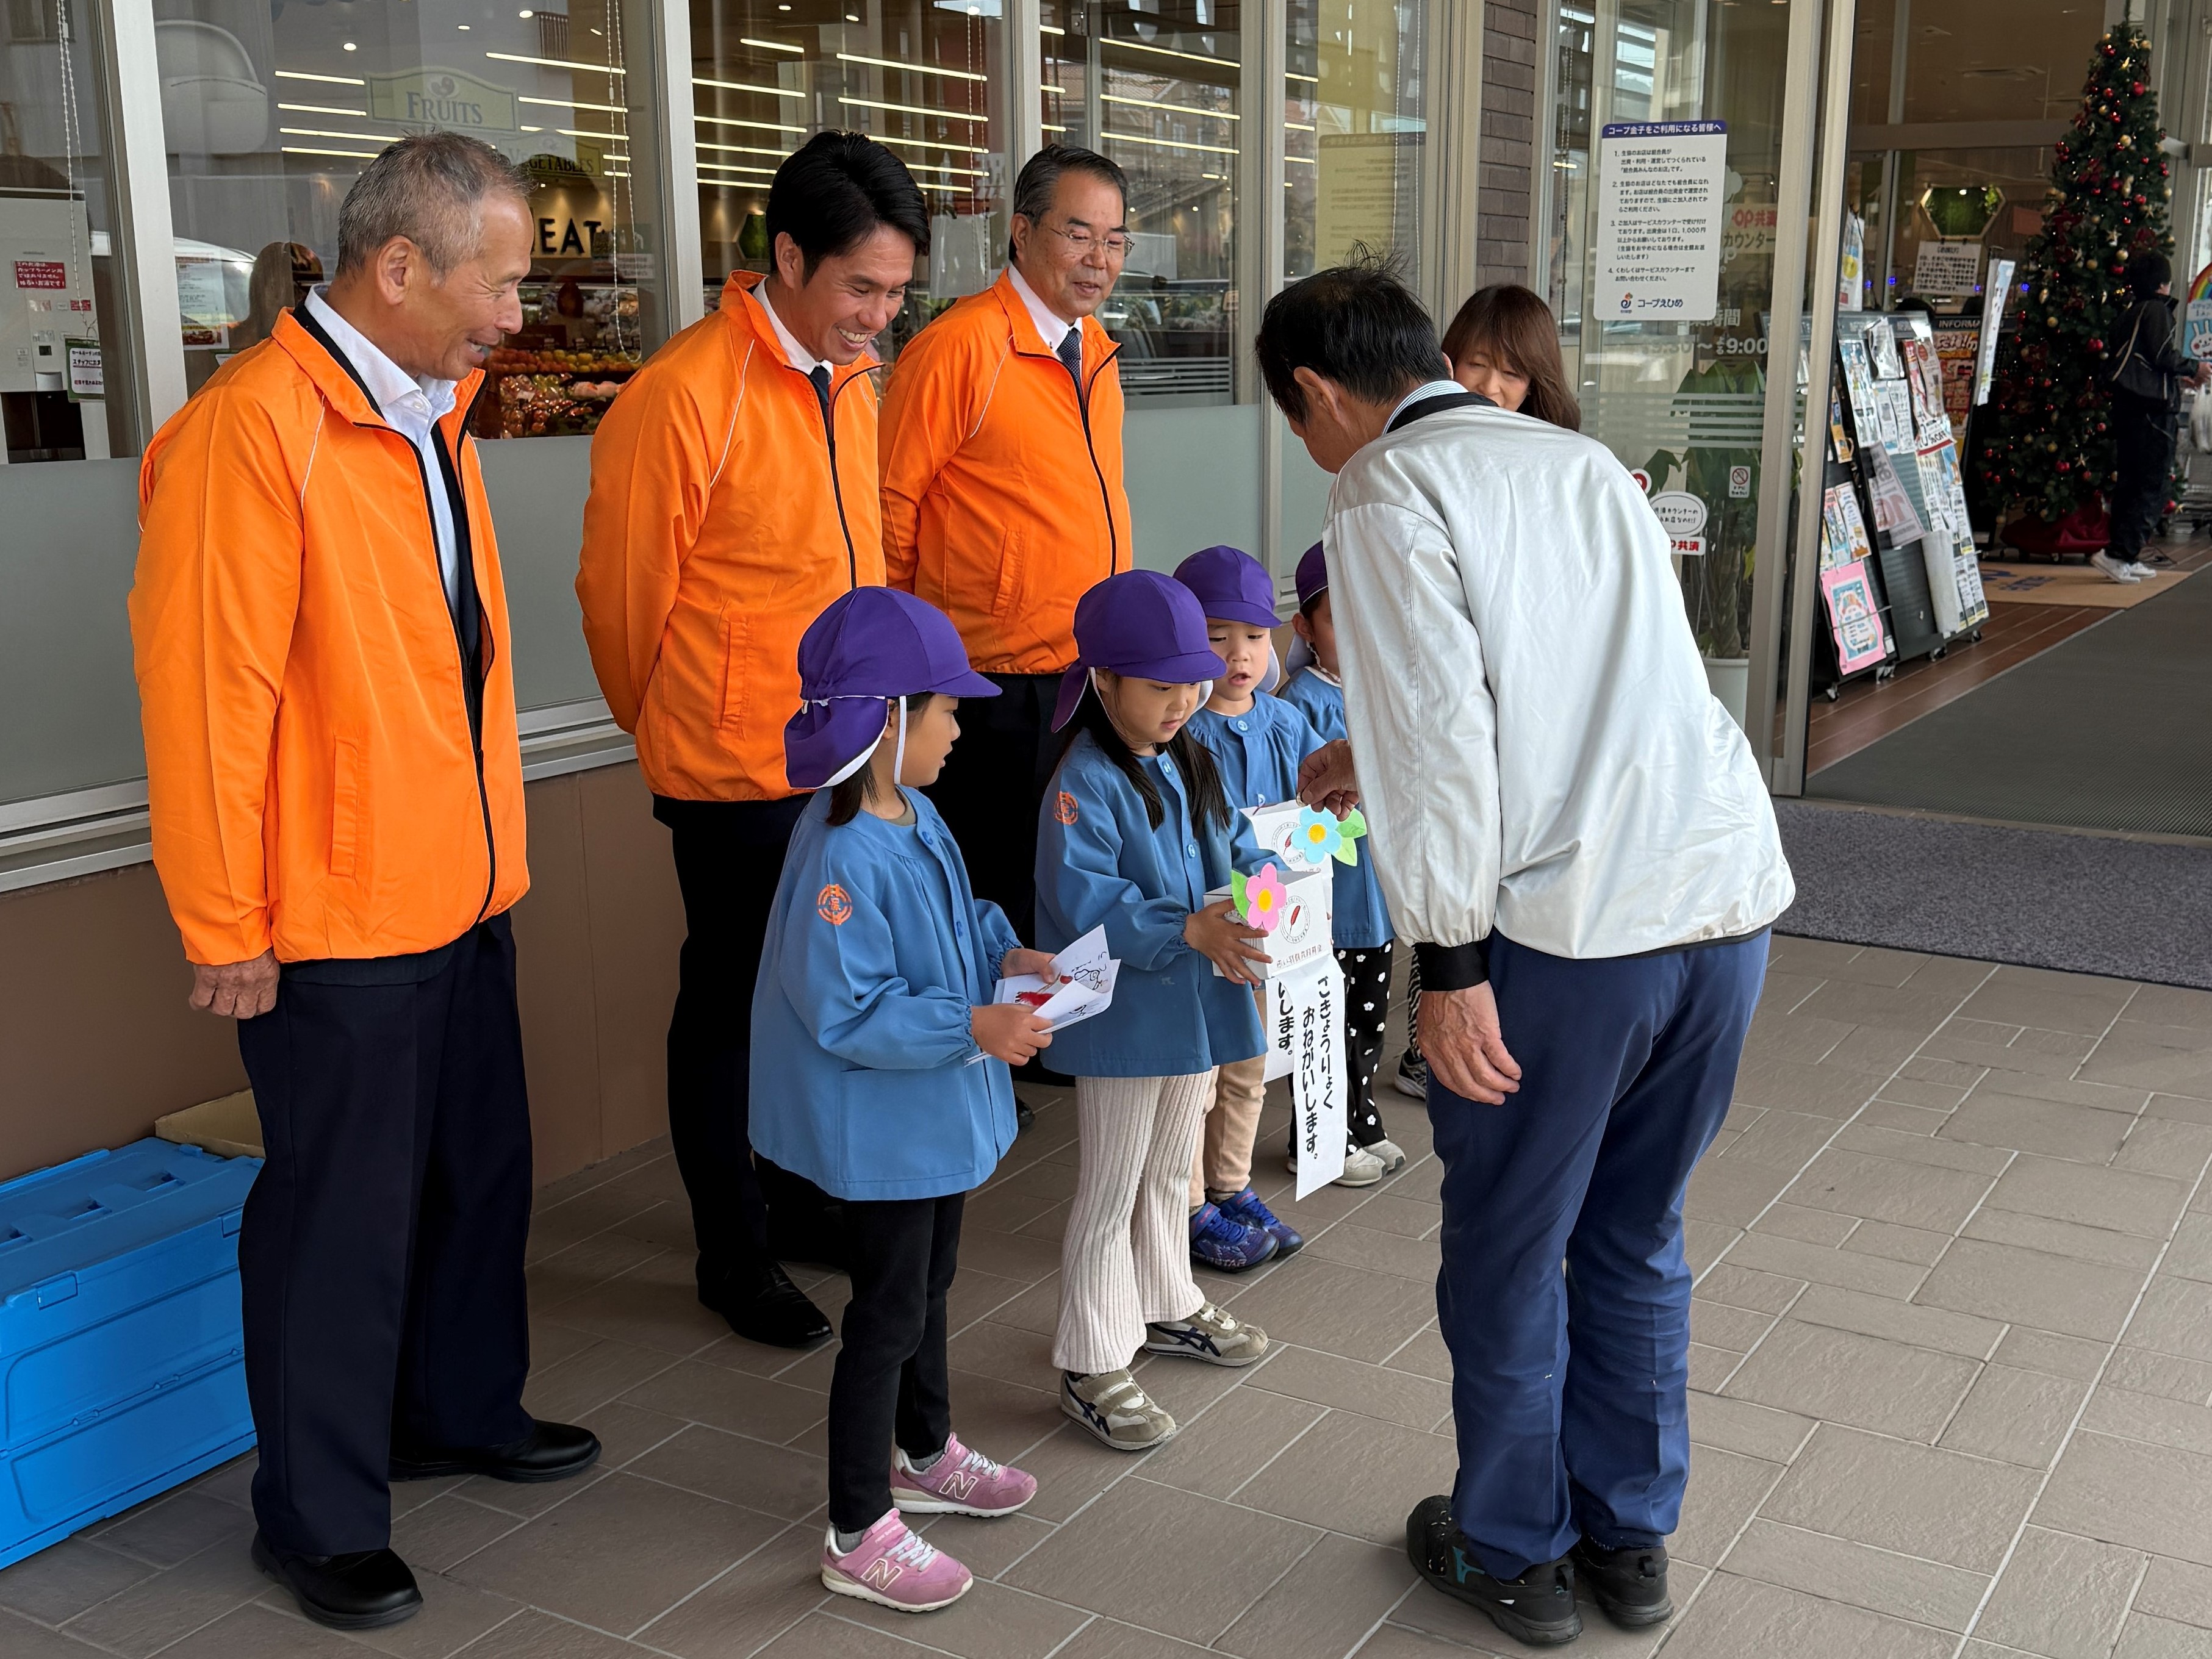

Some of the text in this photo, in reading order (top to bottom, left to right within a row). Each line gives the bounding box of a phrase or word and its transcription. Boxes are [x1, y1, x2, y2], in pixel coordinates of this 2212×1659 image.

[406, 91, 482, 124] FRUITS
[531, 216, 601, 256] EAT
[1637, 298, 1684, 308] コープえひめ
[1726, 338, 1769, 354] 9:00
[1302, 1006, 1318, 1160] おねがいします。
[938, 1471, 980, 1500] N
[860, 1557, 903, 1591] N
